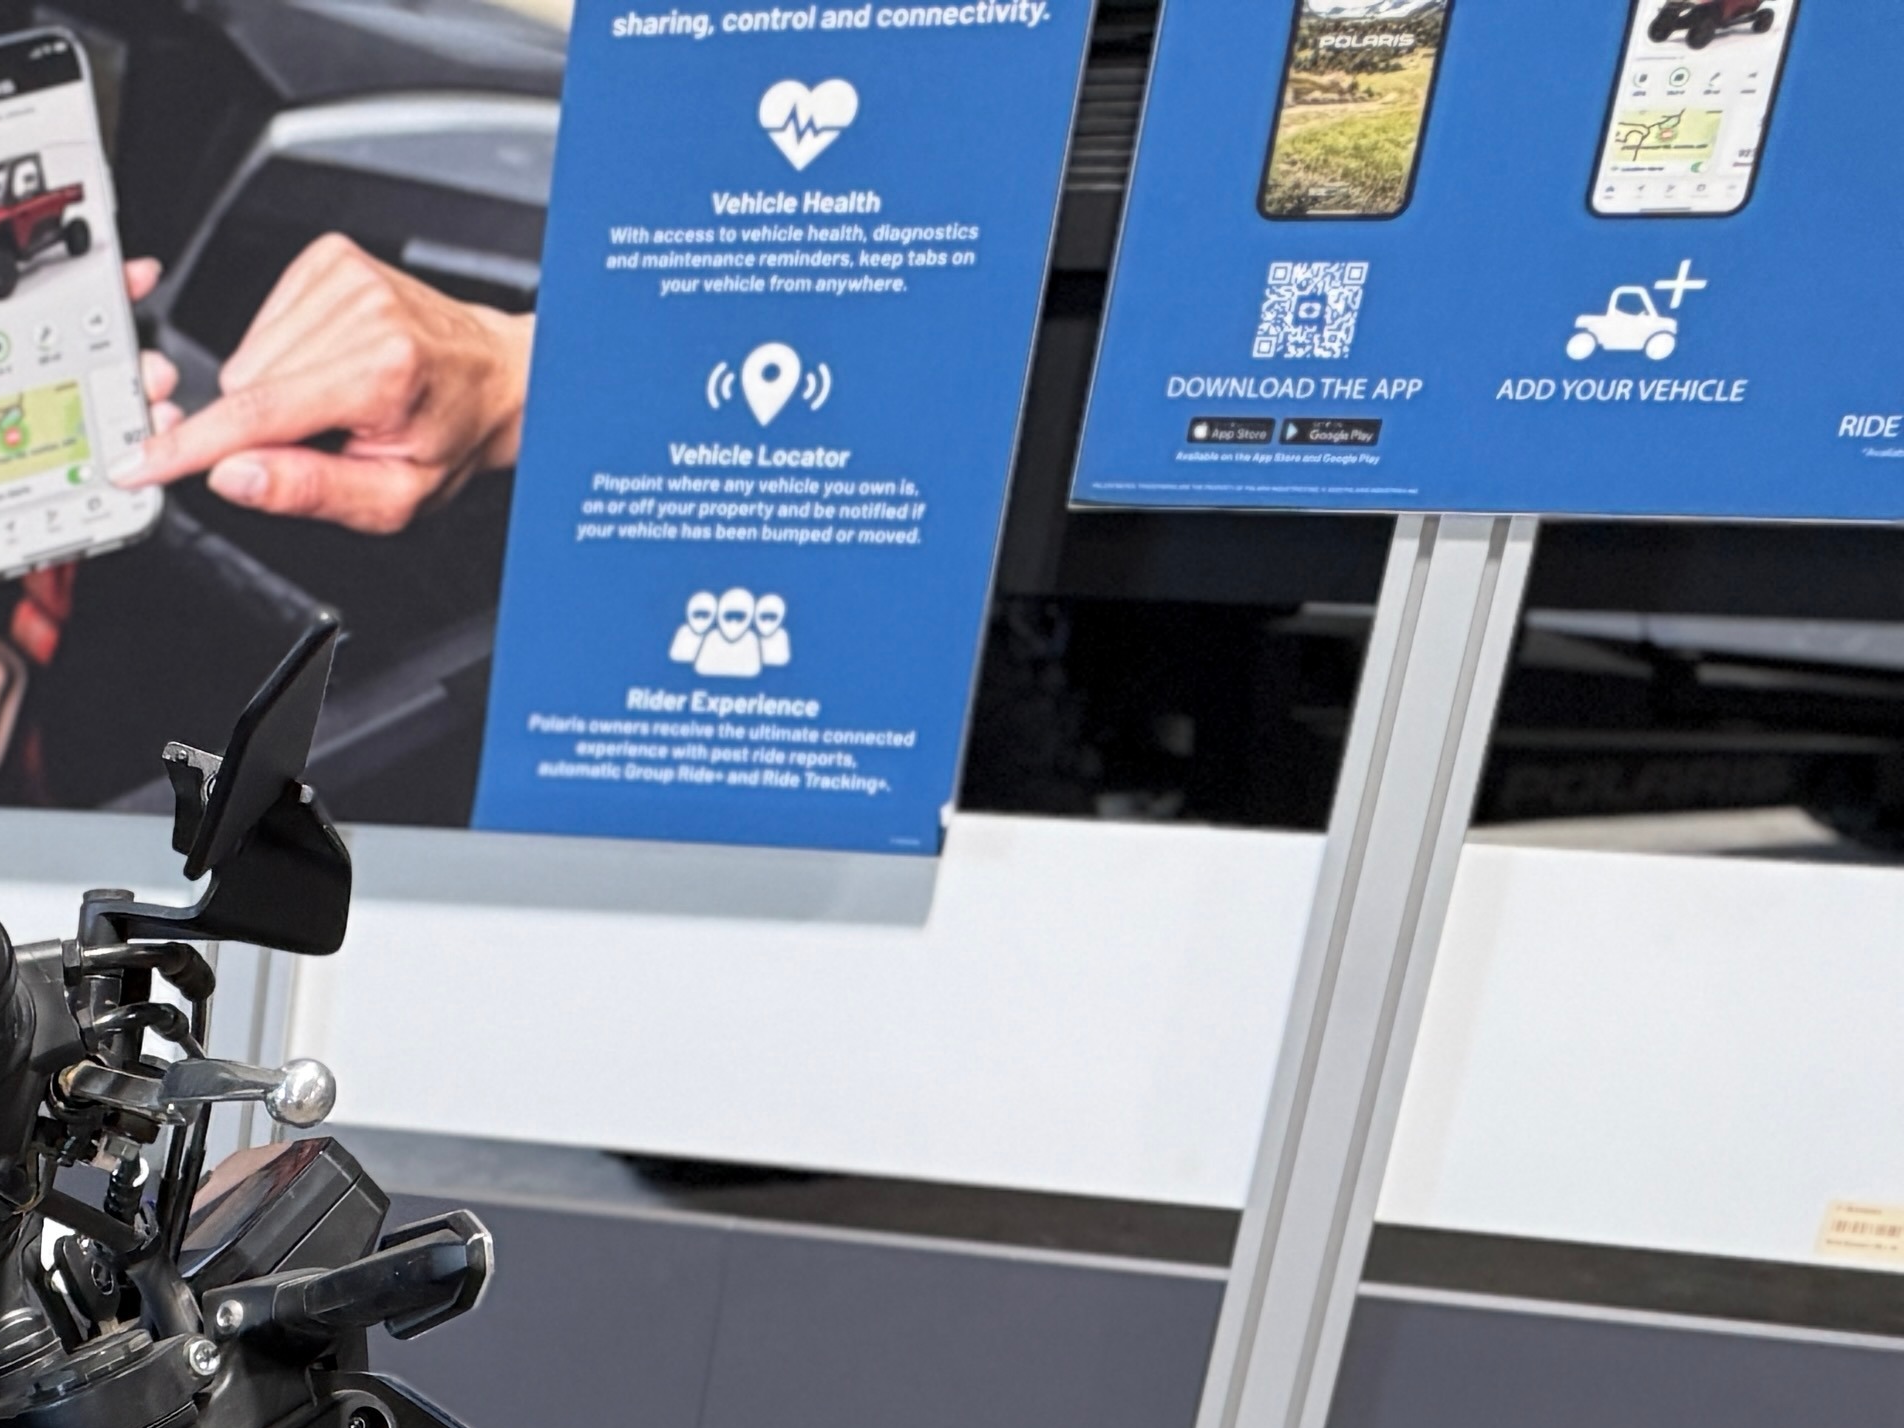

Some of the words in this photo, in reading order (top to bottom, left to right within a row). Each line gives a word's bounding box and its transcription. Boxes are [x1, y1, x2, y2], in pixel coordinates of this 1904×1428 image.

[613, 10, 714, 39] sharing,
[722, 5, 816, 32] control
[820, 4, 871, 29] and
[877, 0, 1049, 27] connectivity.
[1320, 34, 1414, 49] POLARIS
[713, 191, 798, 214] Vehicle
[803, 191, 880, 213] Health
[611, 227, 649, 243] With
[653, 229, 714, 243] access
[719, 227, 737, 242] to
[741, 225, 804, 242] vehicle
[807, 224, 867, 242] health,
[873, 223, 978, 245] diagnostics
[606, 252, 639, 268] and
[640, 251, 756, 268] maintenance
[759, 250, 853, 267] reminders,
[859, 250, 903, 269] keep
[908, 249, 948, 266] tabs
[952, 251, 975, 265] on
[661, 279, 699, 296] your
[703, 275, 765, 292] vehicle
[770, 275, 812, 292] from
[815, 275, 906, 295] anywhere.
[1167, 377, 1315, 398] DOWNLOAD
[1321, 378, 1367, 399] THE
[1372, 378, 1423, 399] APP
[1496, 379, 1555, 400] ADD
[1563, 379, 1633, 400] YOUR
[1639, 379, 1747, 401] VEHICLE
[1839, 415, 1902, 437] RIDE
[670, 444, 753, 466] Vehicle
[757, 445, 850, 468] Locator
[593, 474, 664, 494] Pinpoint
[667, 476, 721, 492] where
[723, 479, 755, 496] any
[759, 477, 819, 494] vehicle
[823, 481, 855, 498] you
[858, 482, 892, 495] own
[899, 479, 918, 496] is,
[583, 501, 603, 513] on
[605, 501, 625, 514] or
[628, 498, 654, 515] off
[657, 502, 695, 518] your
[698, 502, 774, 520] property
[777, 502, 810, 518] and
[812, 502, 836, 518] be
[839, 503, 907, 519] notified
[911, 503, 925, 519] if
[577, 524, 614, 540] your
[617, 522, 677, 539] vehicle
[679, 523, 712, 539] has
[715, 524, 758, 540] been
[761, 524, 832, 544] bumped
[835, 529, 855, 542] or
[858, 528, 920, 544] moved.
[627, 688, 687, 711] Rider
[691, 691, 819, 717] Experience
[528, 714, 585, 733] Polaris
[588, 720, 650, 735] owners
[652, 722, 714, 738] receive
[717, 723, 746, 739] the
[747, 724, 820, 743] ultimate
[821, 730, 915, 747] connected
[576, 741, 668, 758] experience
[671, 744, 706, 759] with
[708, 747, 748, 763] post
[752, 748, 786, 764] ride
[538, 761, 621, 779] automatic
[623, 763, 675, 783] Group
[726, 770, 759, 785] and
[761, 769, 800, 787] Ride
